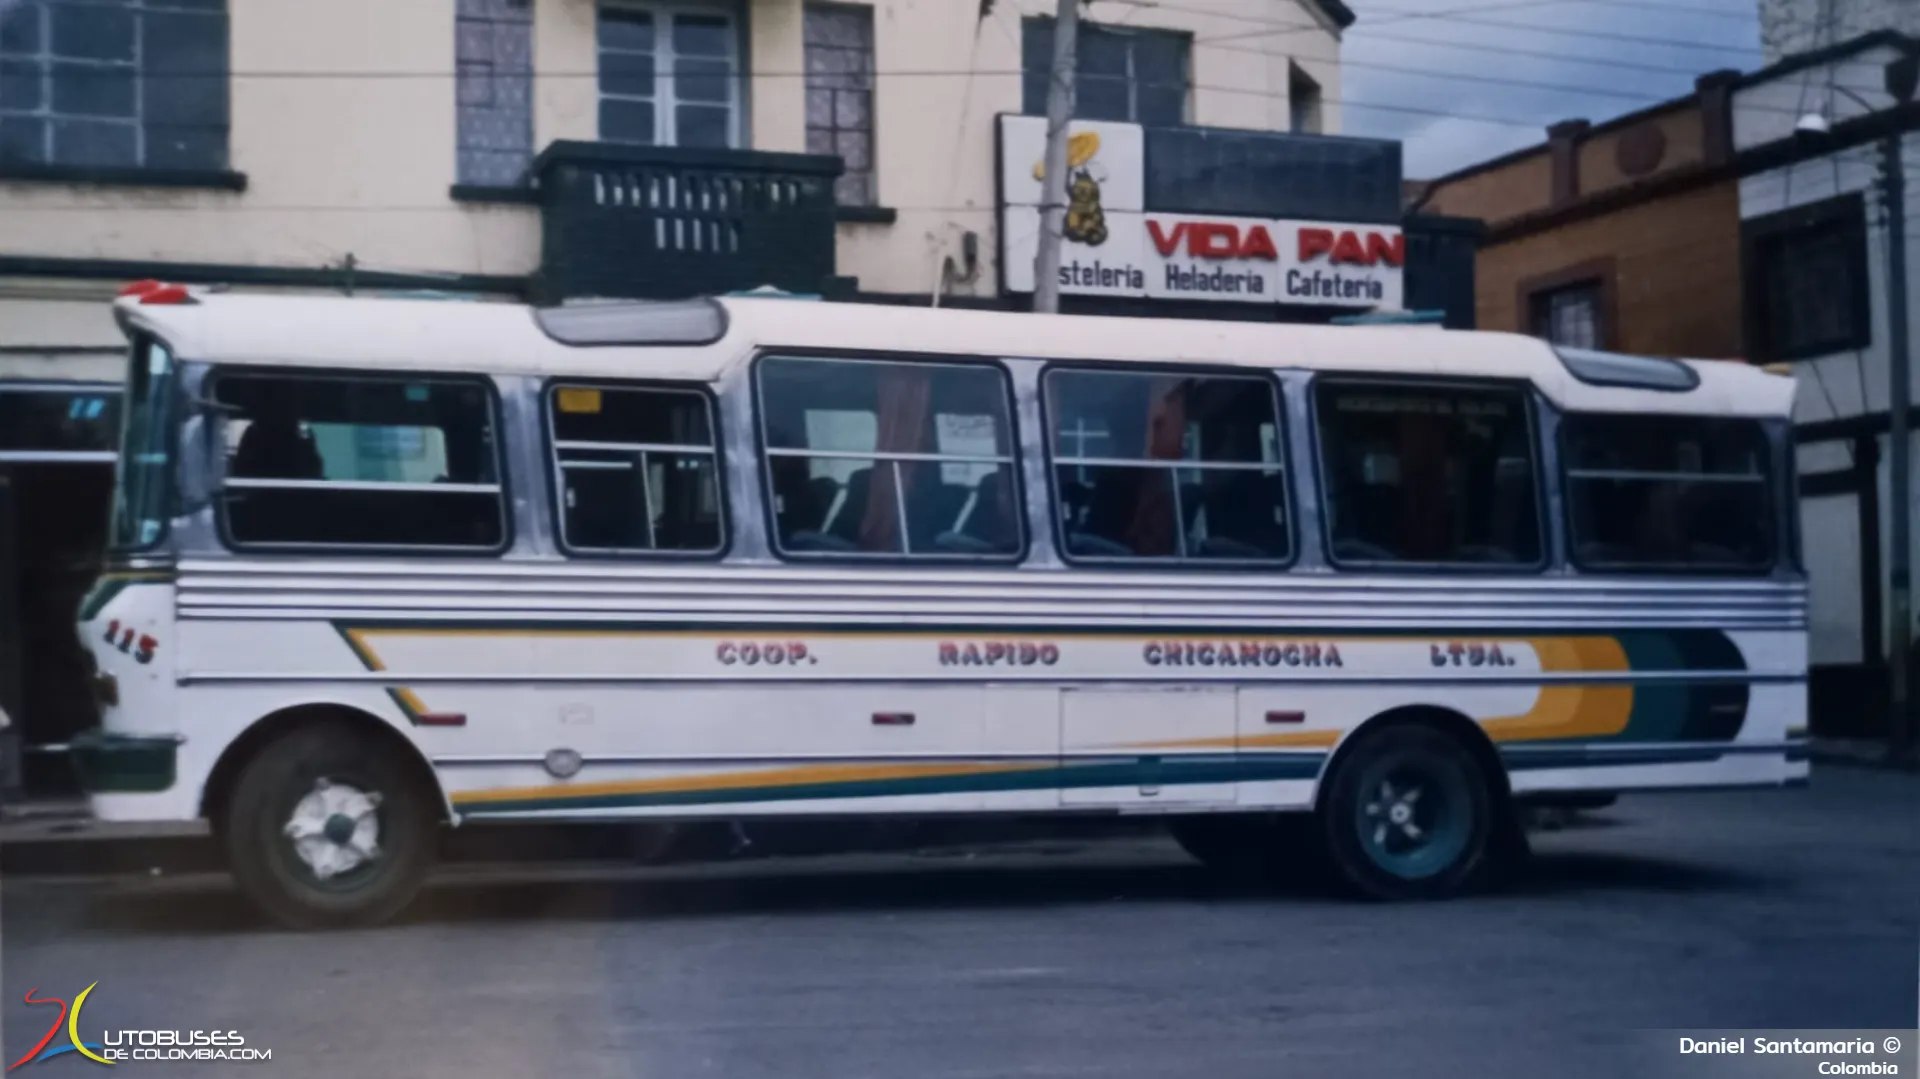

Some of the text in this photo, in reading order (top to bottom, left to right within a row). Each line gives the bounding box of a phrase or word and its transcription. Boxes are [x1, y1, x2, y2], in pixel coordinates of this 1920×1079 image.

[1145, 219, 1405, 267] VIDA PAN
[103, 619, 158, 664] 115
[715, 641, 1516, 667] COOP. RAPIDO CHICAMOCHA LTDA.
